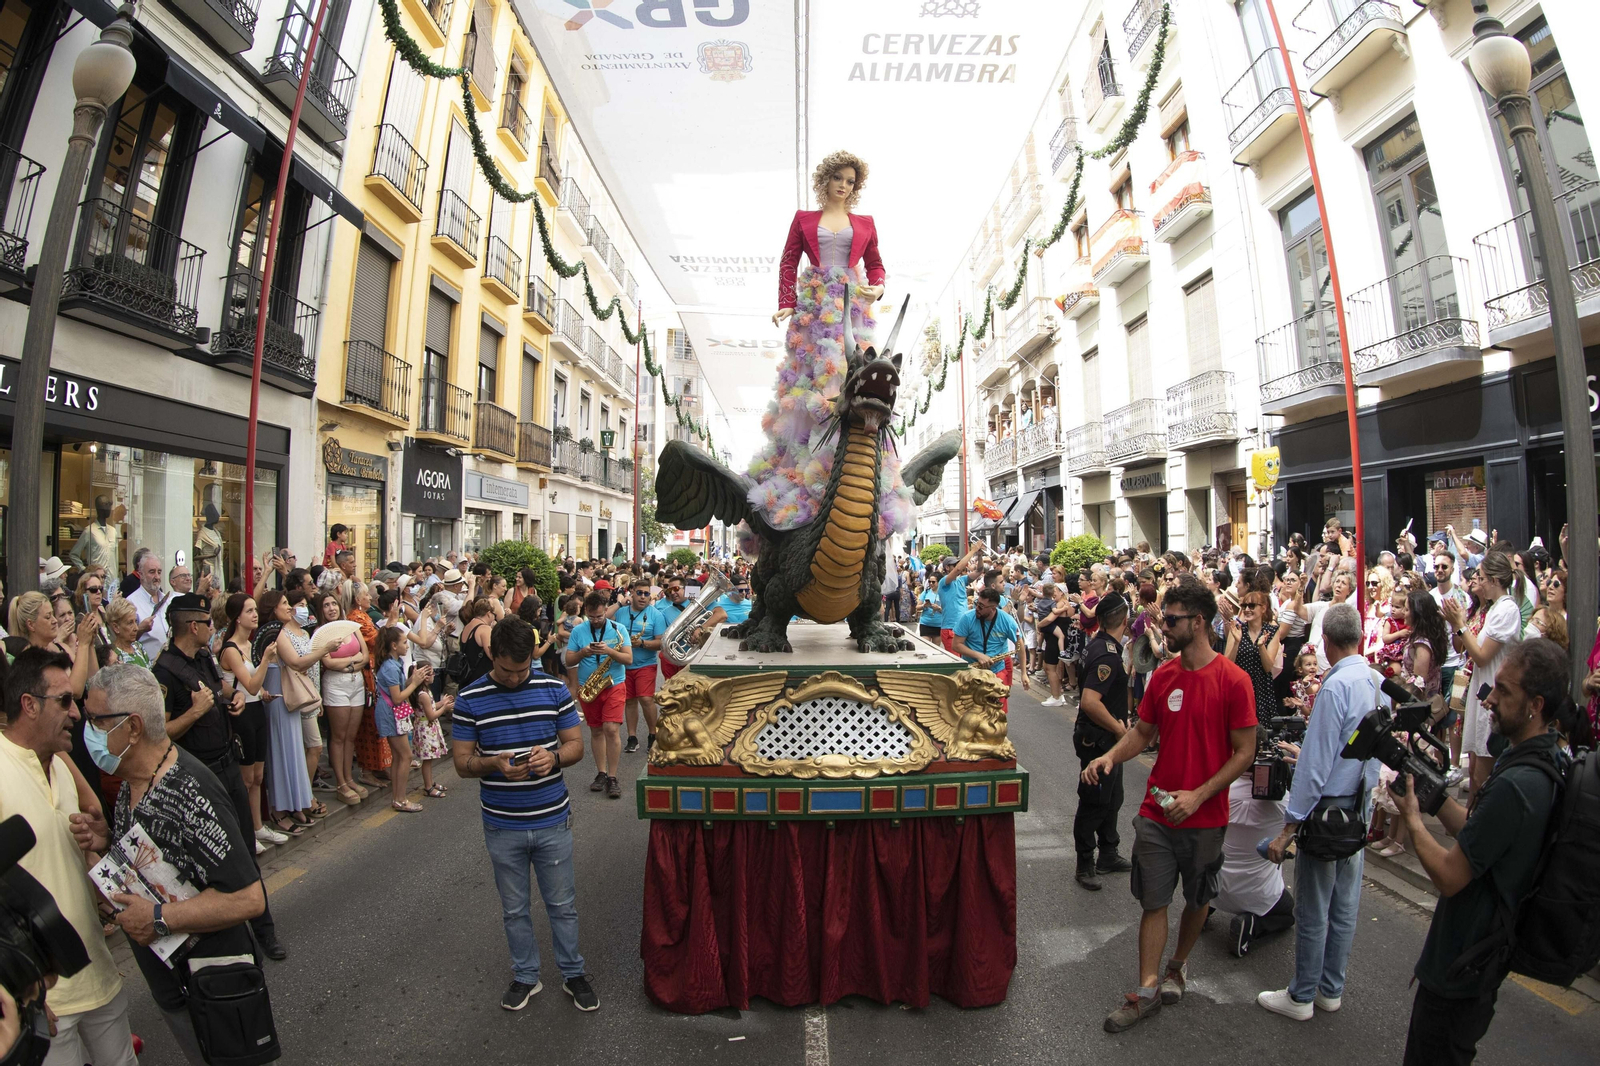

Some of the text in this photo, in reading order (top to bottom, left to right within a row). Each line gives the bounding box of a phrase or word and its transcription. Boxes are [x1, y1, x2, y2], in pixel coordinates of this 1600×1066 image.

[861, 32, 1021, 56] CERVEZAS
[847, 62, 1017, 84] ALHAMBRA
[669, 254, 776, 265] ALHAMBRA
[680, 264, 771, 274] CERVEZAS
[416, 468, 451, 490] AGORA
[423, 490, 445, 501] JOYAS
[486, 480, 518, 499] intemerata
